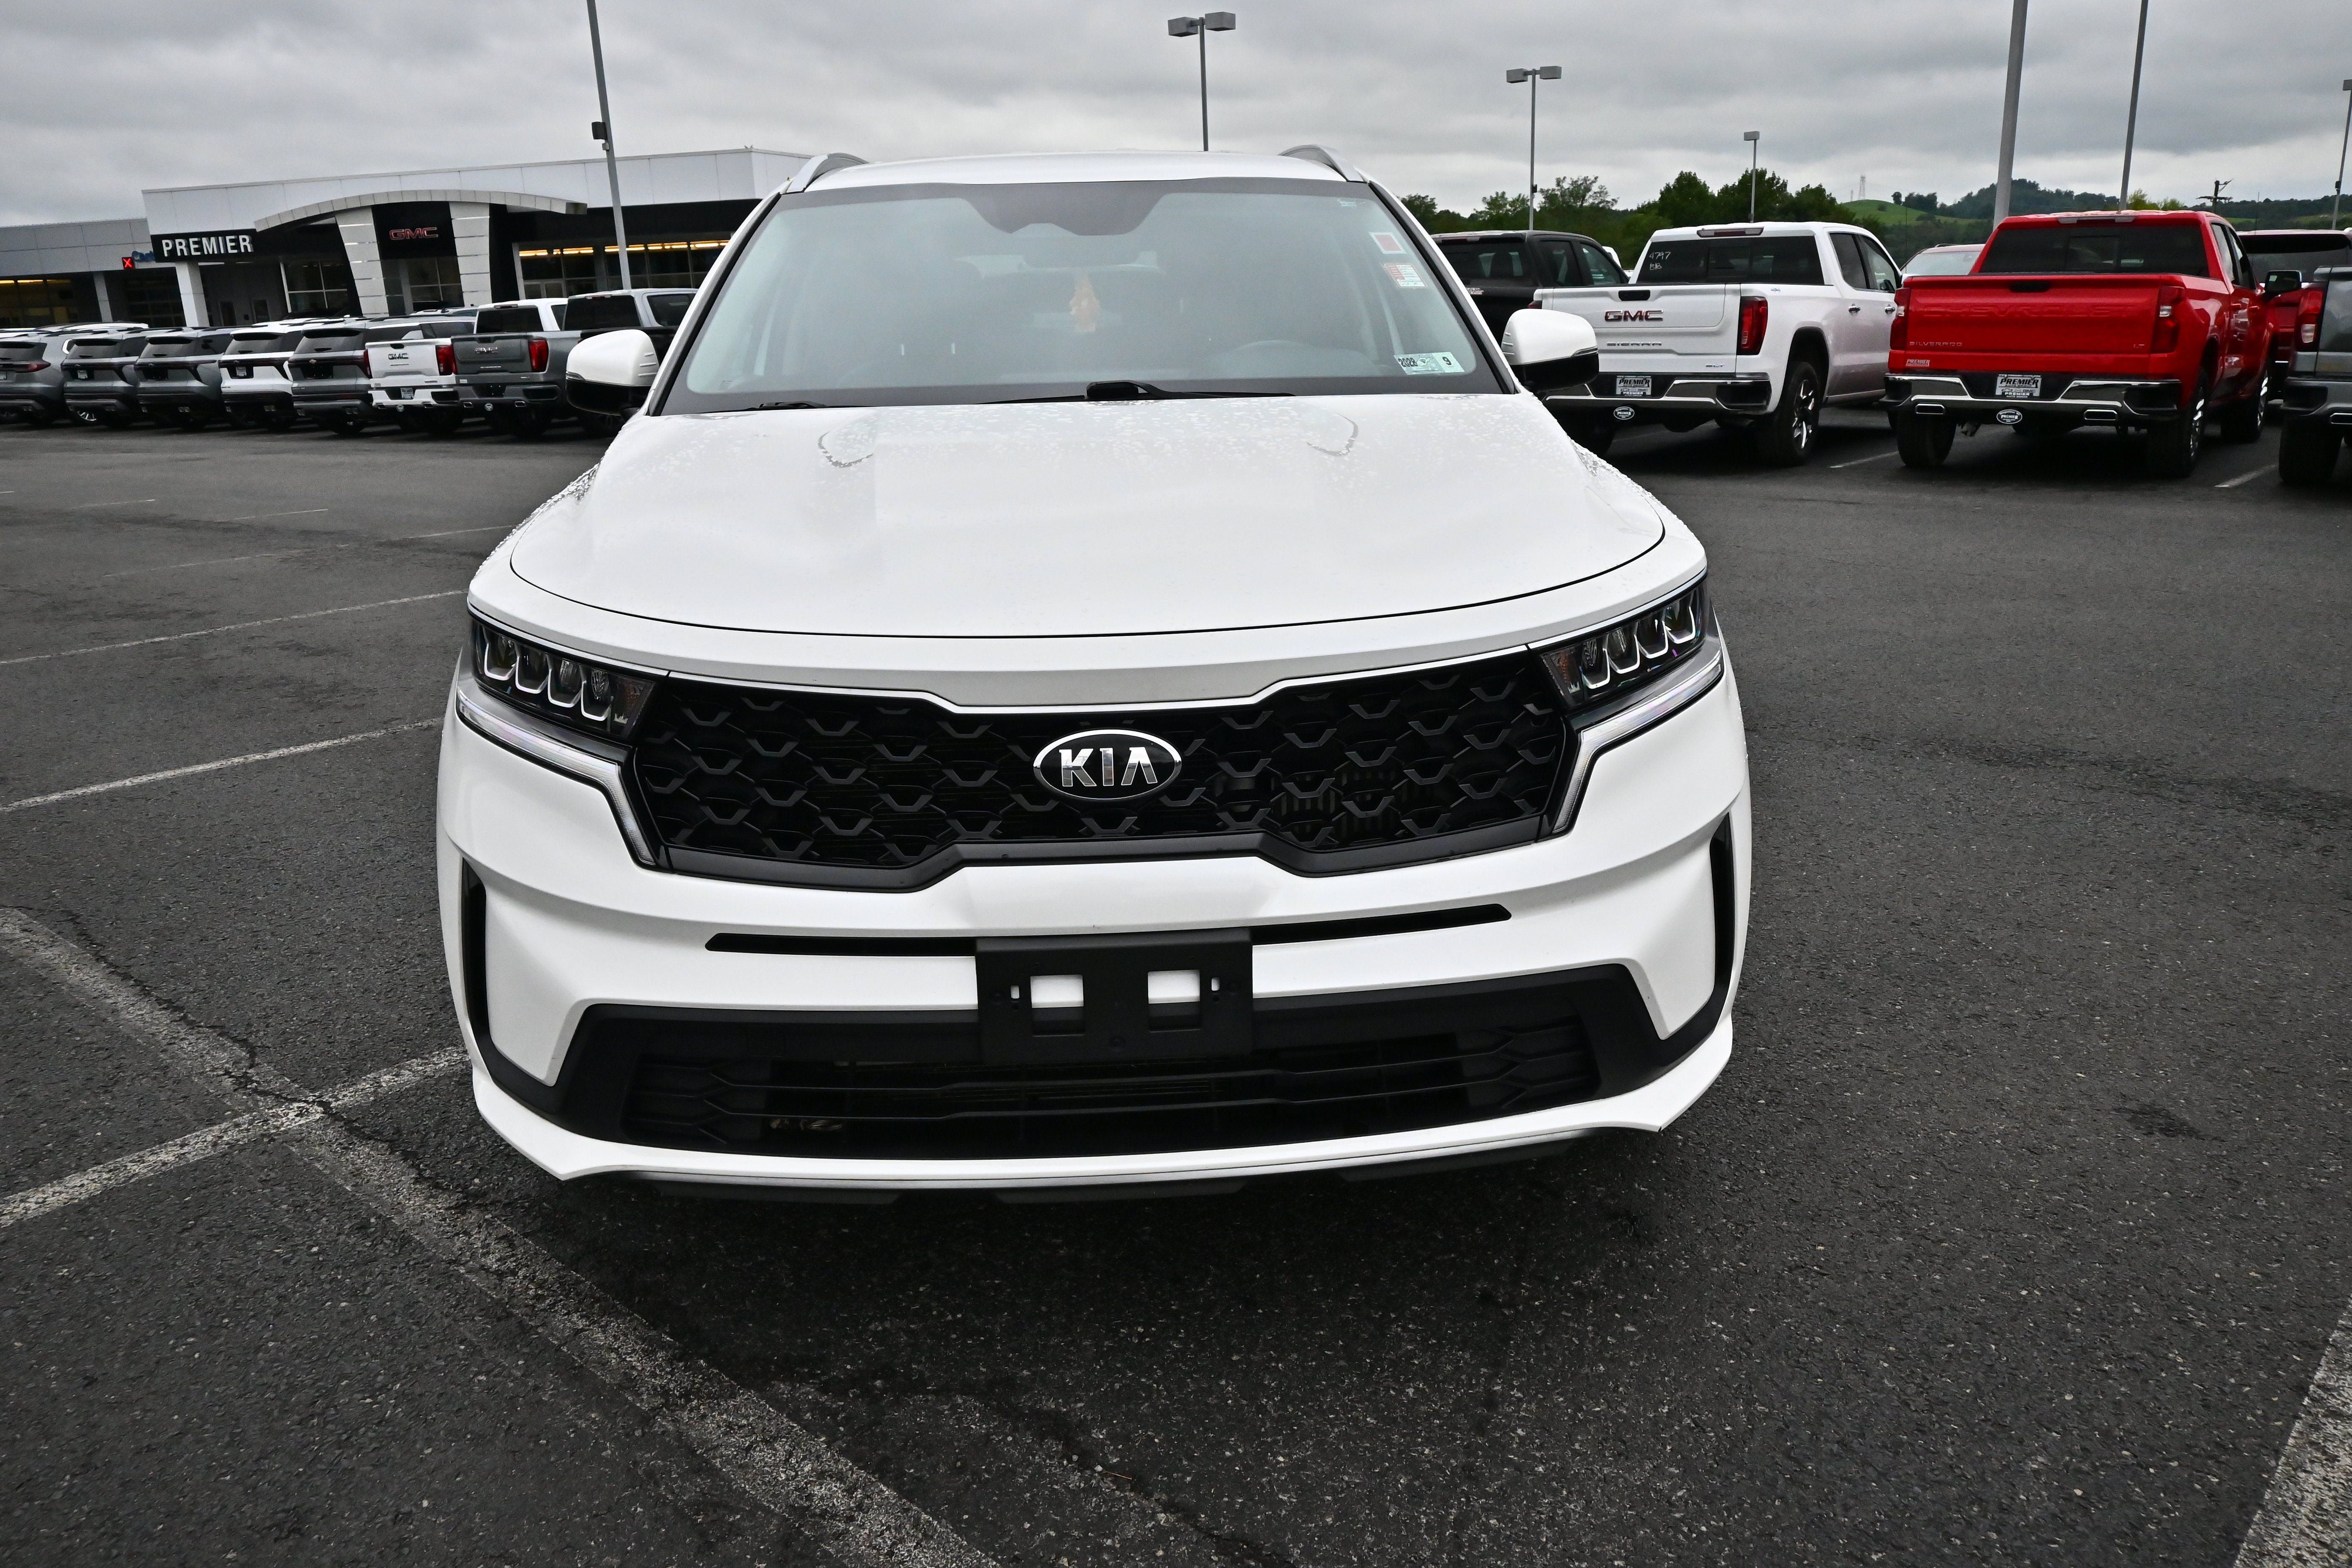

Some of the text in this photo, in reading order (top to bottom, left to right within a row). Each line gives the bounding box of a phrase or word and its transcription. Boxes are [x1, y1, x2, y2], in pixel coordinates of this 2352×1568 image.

[389, 227, 438, 240] GMC
[162, 235, 253, 257] PREMIER
[1649, 251, 1671, 260] 4797
[1605, 310, 1663, 321] GMC
[1442, 357, 1452, 365] 9
[1619, 379, 1650, 387] PREMIER
[2000, 379, 2039, 388] PREMIER
[1059, 746, 1158, 787] KIA
